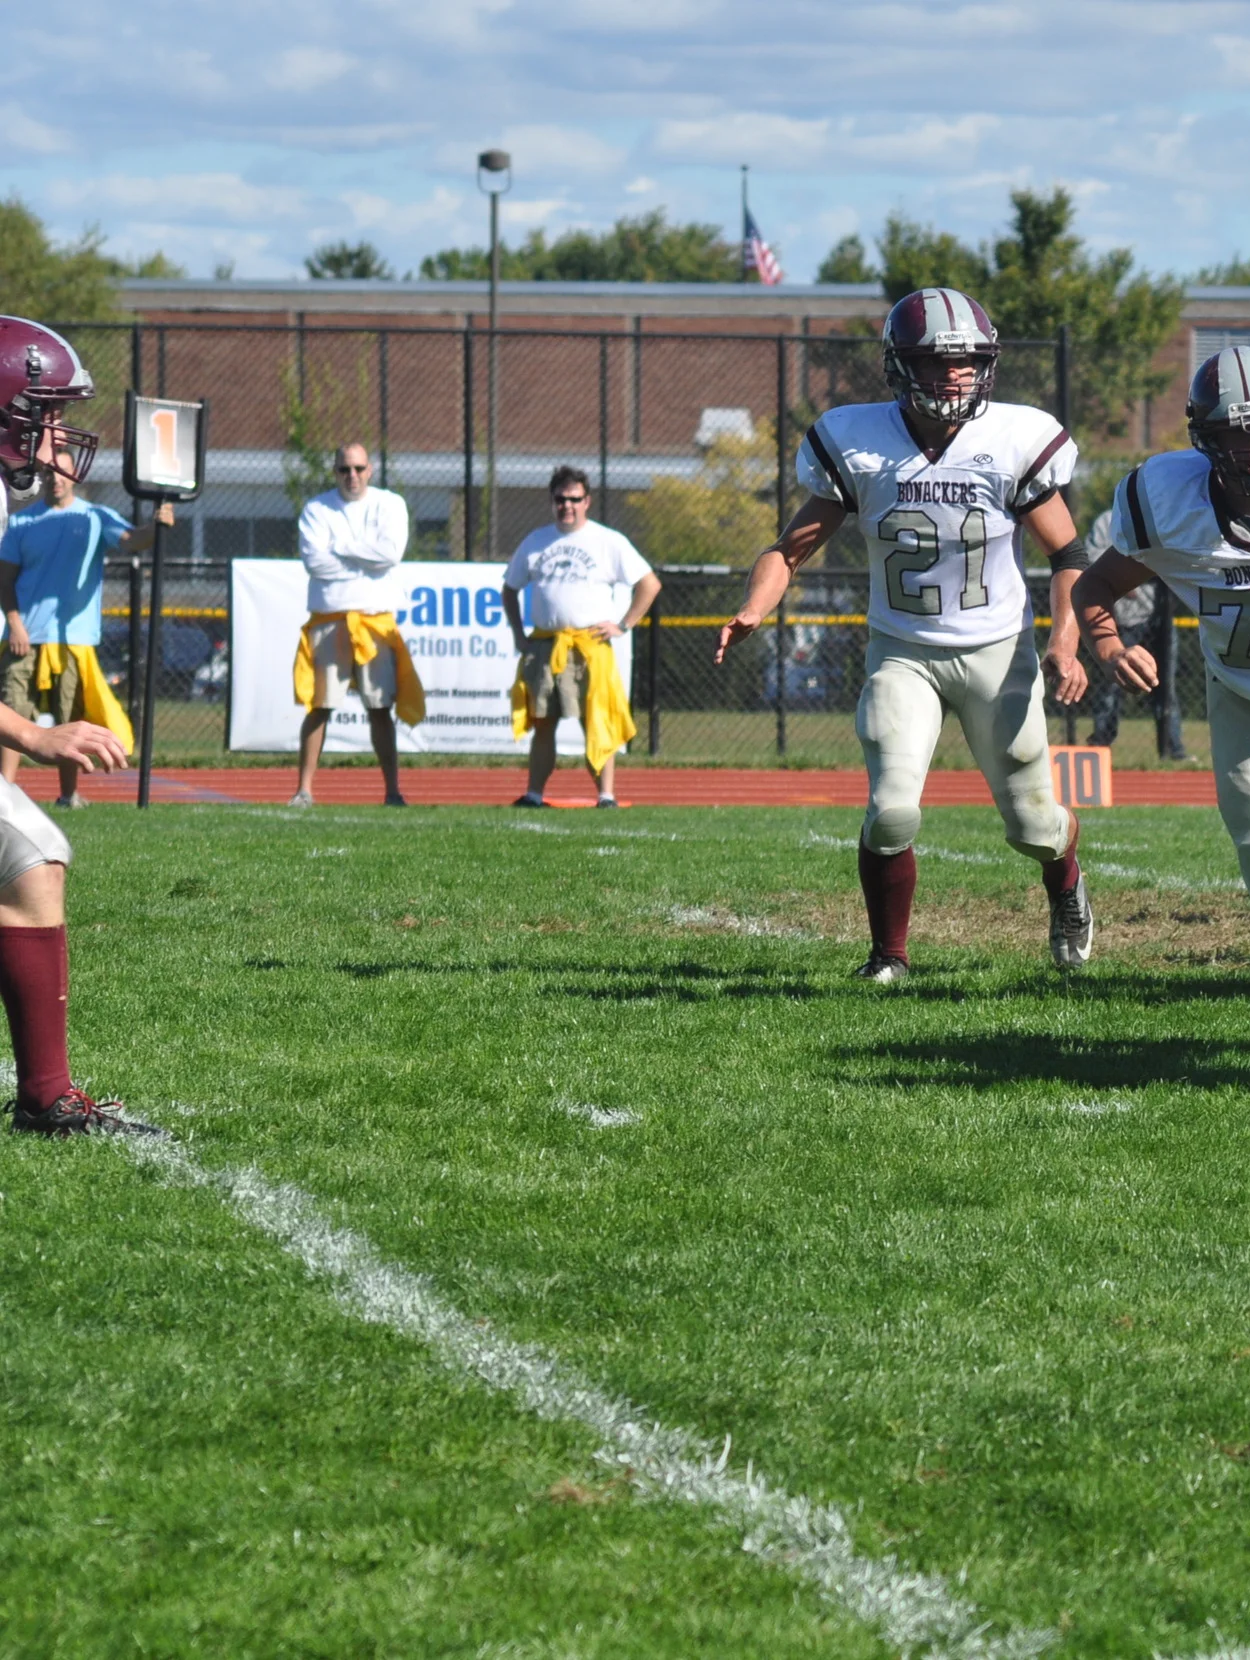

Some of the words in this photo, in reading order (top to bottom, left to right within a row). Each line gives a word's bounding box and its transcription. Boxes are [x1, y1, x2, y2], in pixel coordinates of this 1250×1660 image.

[151, 409, 181, 475] 1
[896, 481, 977, 504] BONACKERS
[878, 509, 989, 615] 21
[1053, 752, 1102, 805] 10
